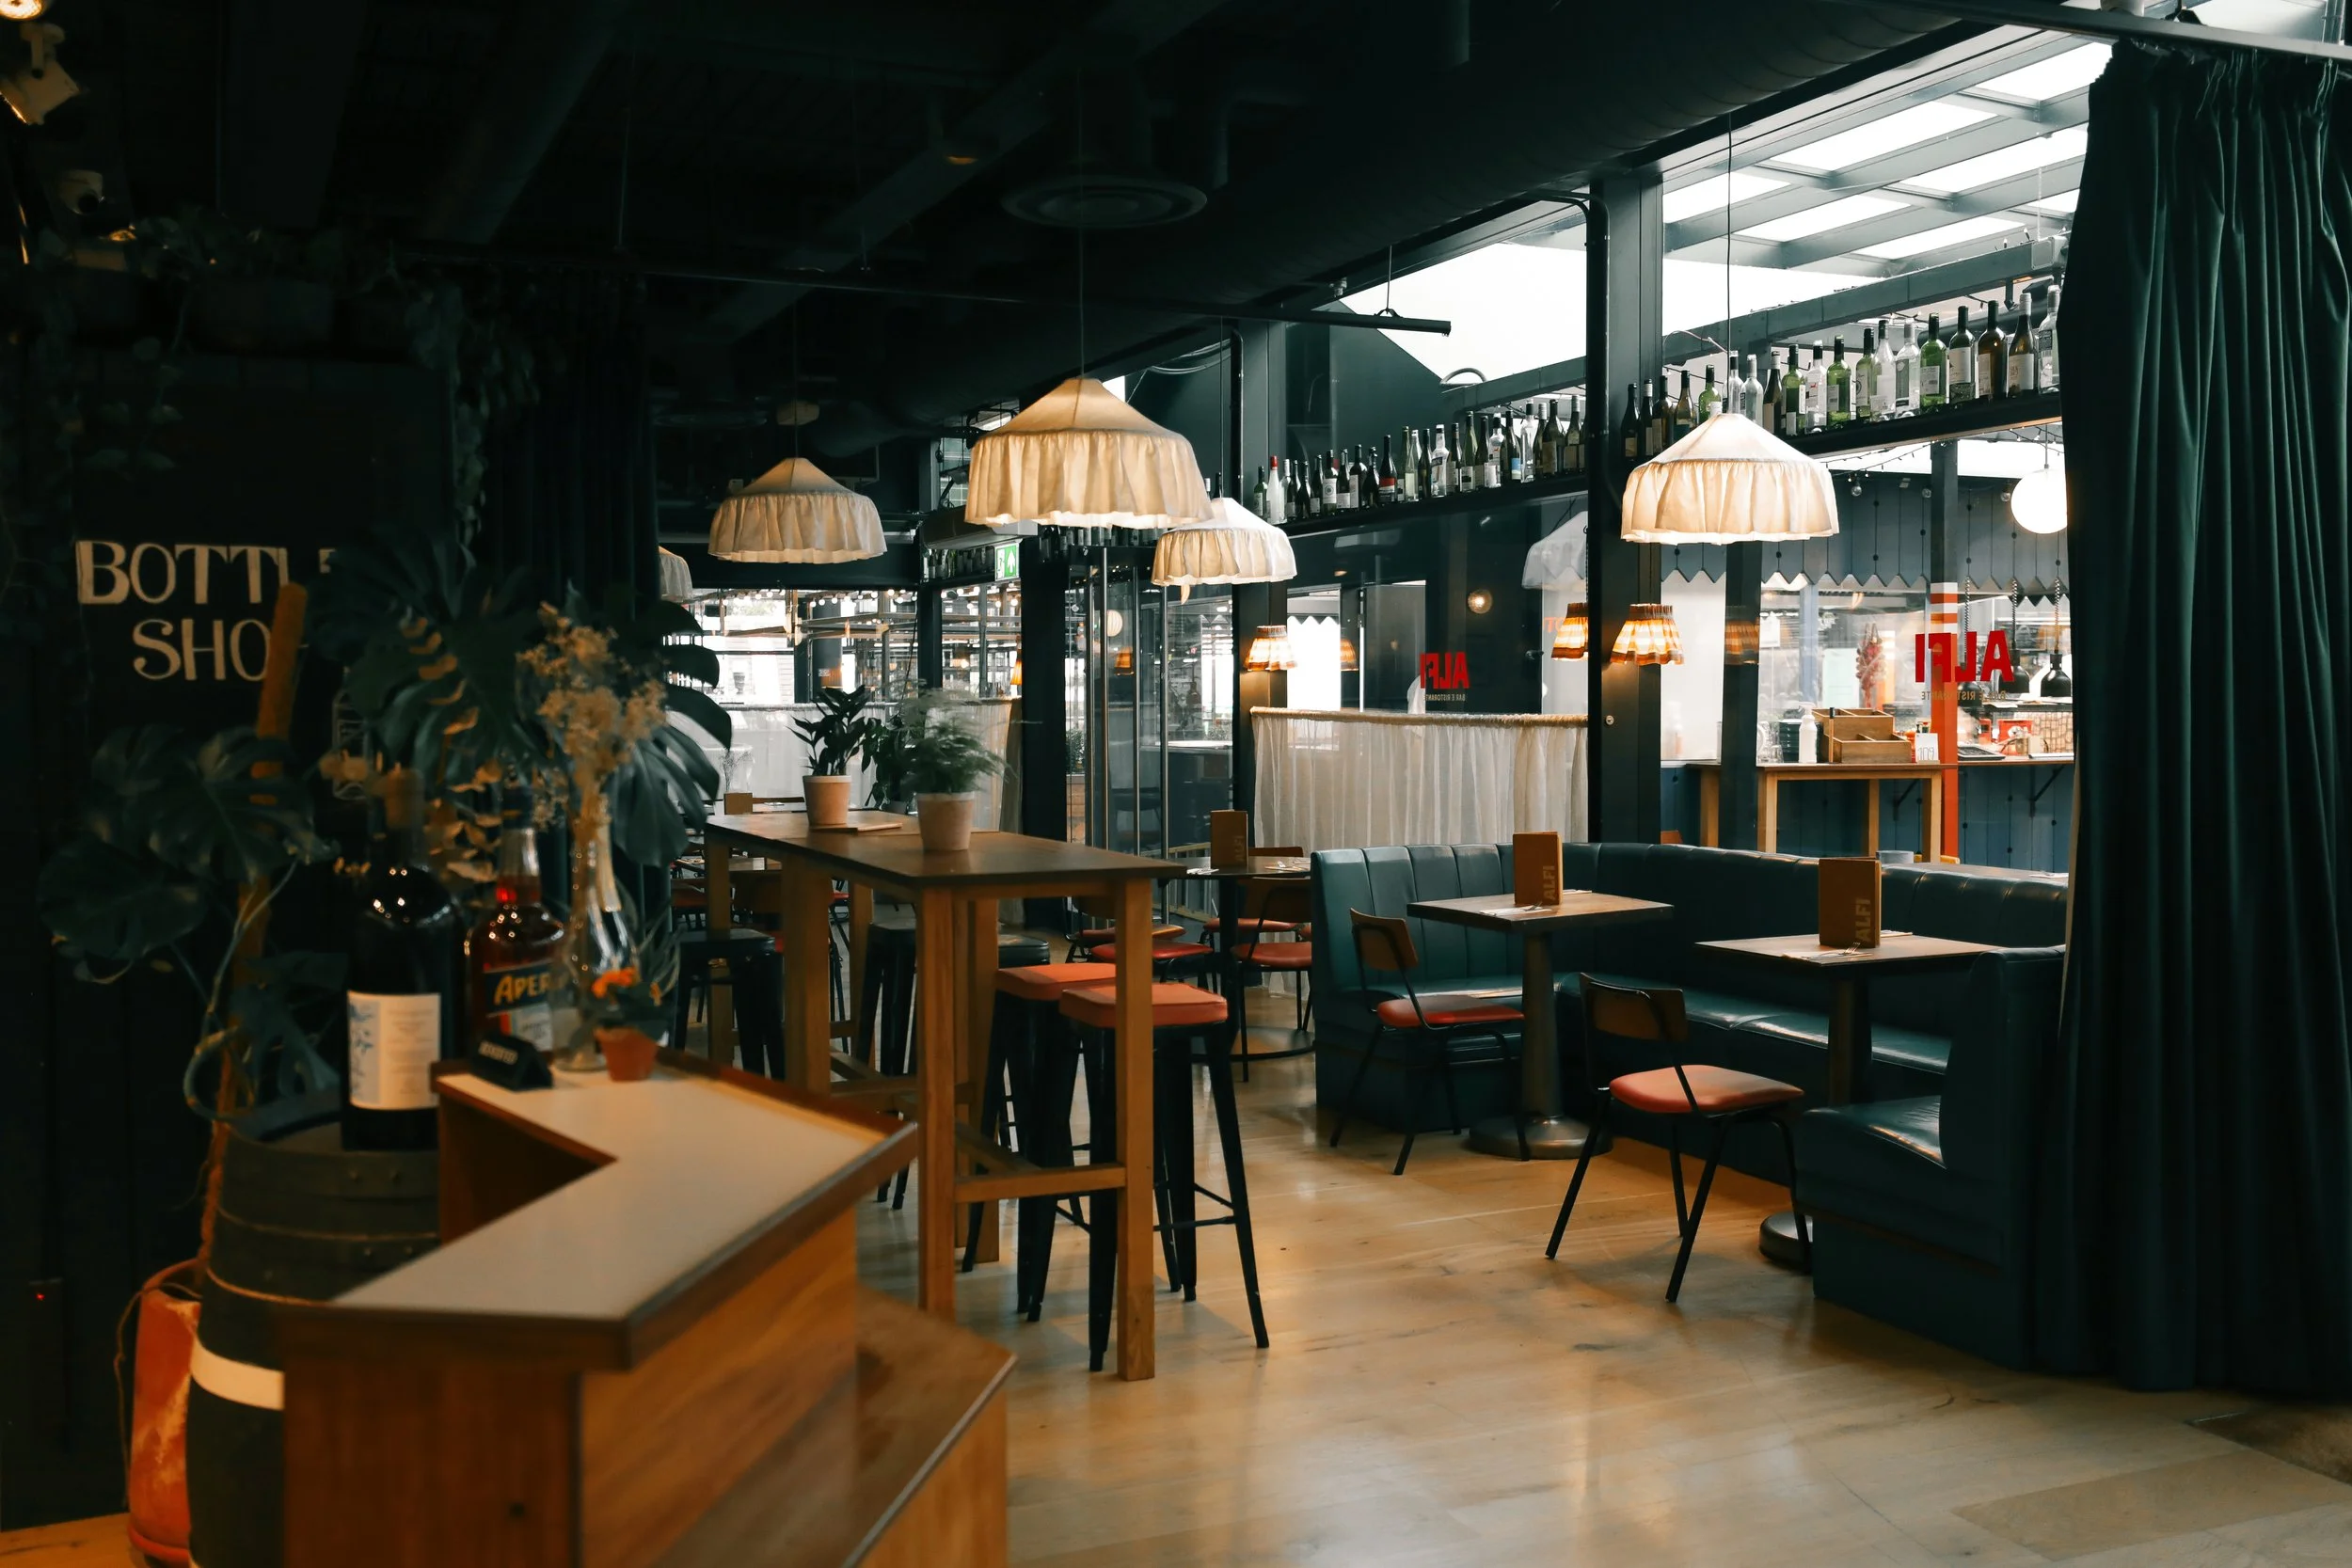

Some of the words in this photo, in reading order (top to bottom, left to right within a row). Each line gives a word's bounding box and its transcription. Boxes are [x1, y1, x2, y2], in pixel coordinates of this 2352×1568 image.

[76, 540, 336, 604] BOTT
[132, 618, 309, 681] SHO
[1543, 865, 1555, 900] ALFI
[1855, 898, 1870, 942] ALFI
[494, 972, 555, 1006] APER
